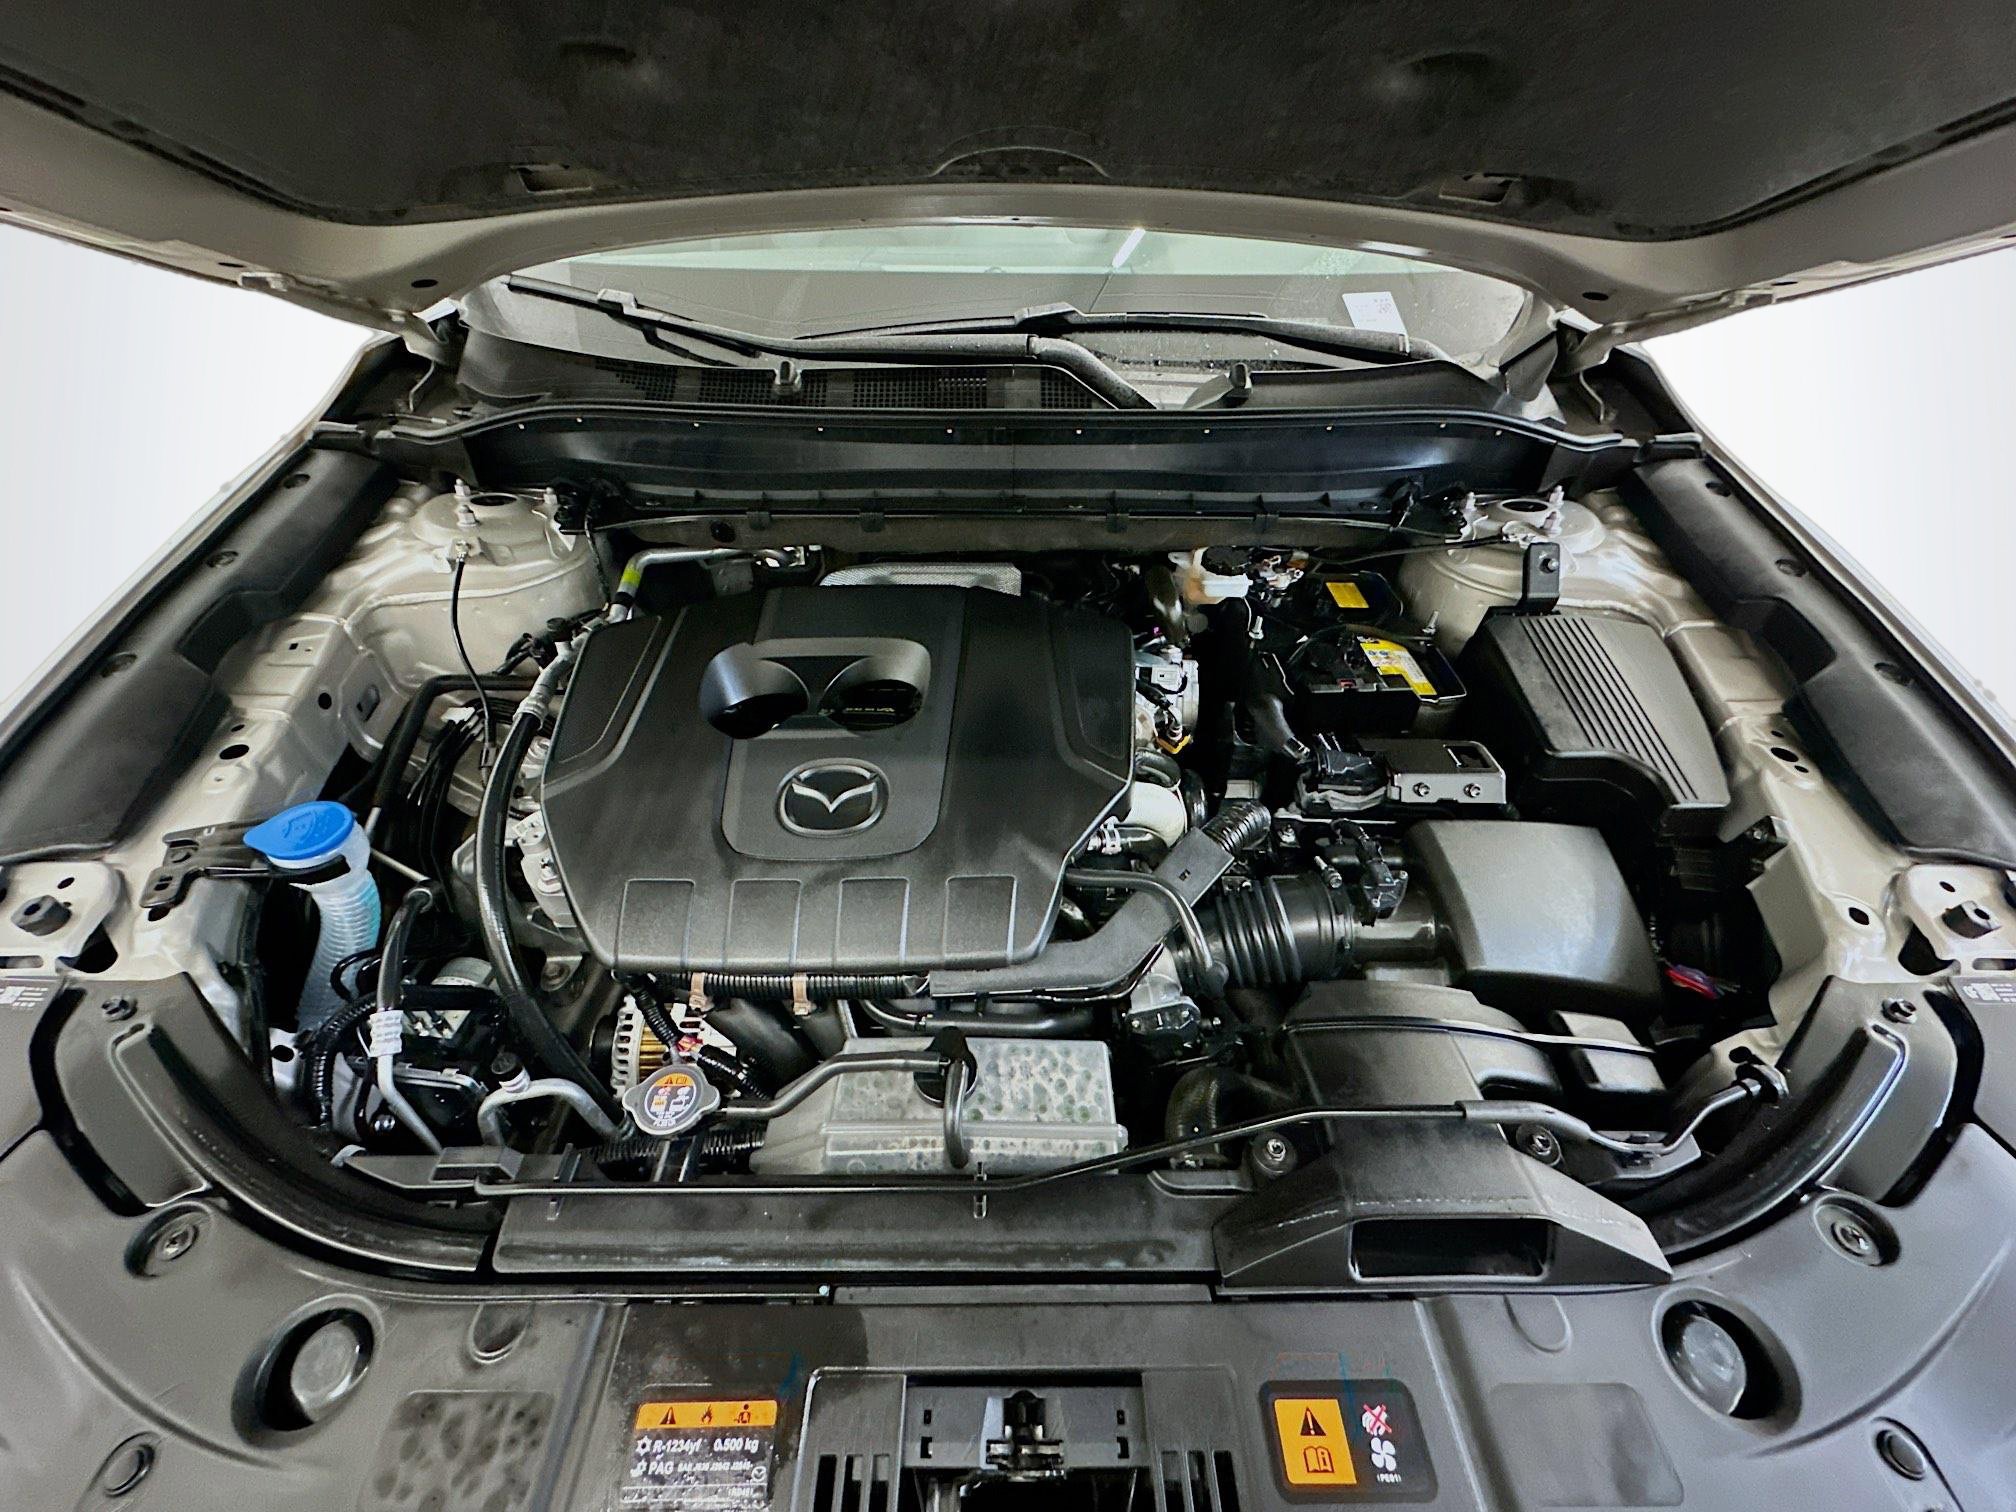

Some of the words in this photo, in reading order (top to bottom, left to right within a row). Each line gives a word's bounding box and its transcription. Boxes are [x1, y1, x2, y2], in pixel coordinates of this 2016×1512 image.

[652, 1438, 702, 1455] R-1234yf
[713, 1437, 743, 1452] 0.500
[744, 1437, 759, 1454] kg
[648, 1461, 674, 1476] PAG
